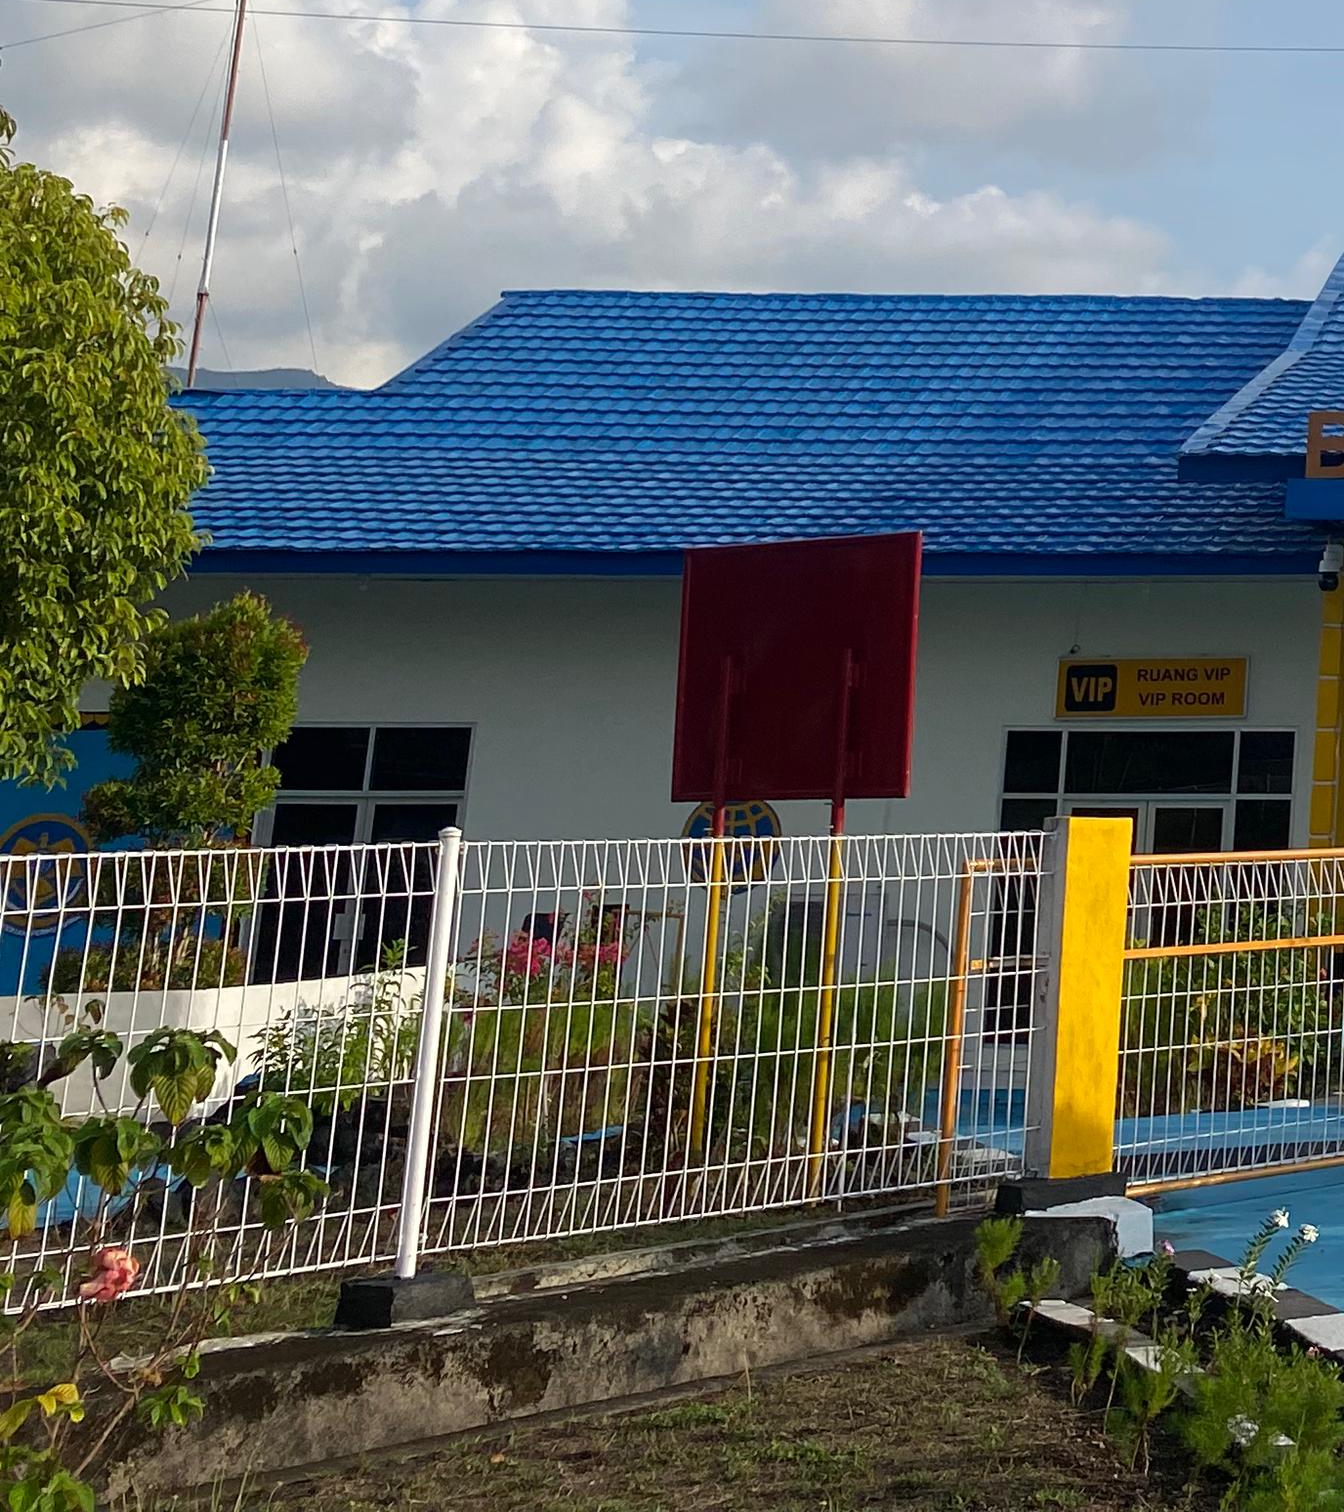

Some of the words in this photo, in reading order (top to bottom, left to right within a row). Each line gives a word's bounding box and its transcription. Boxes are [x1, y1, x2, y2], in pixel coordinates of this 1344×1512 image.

[1137, 669, 1198, 682] RUANG
[1204, 668, 1231, 681] VIP
[1072, 676, 1113, 703] VIP
[1139, 693, 1166, 706] VIP
[1171, 692, 1225, 705] ROOM
